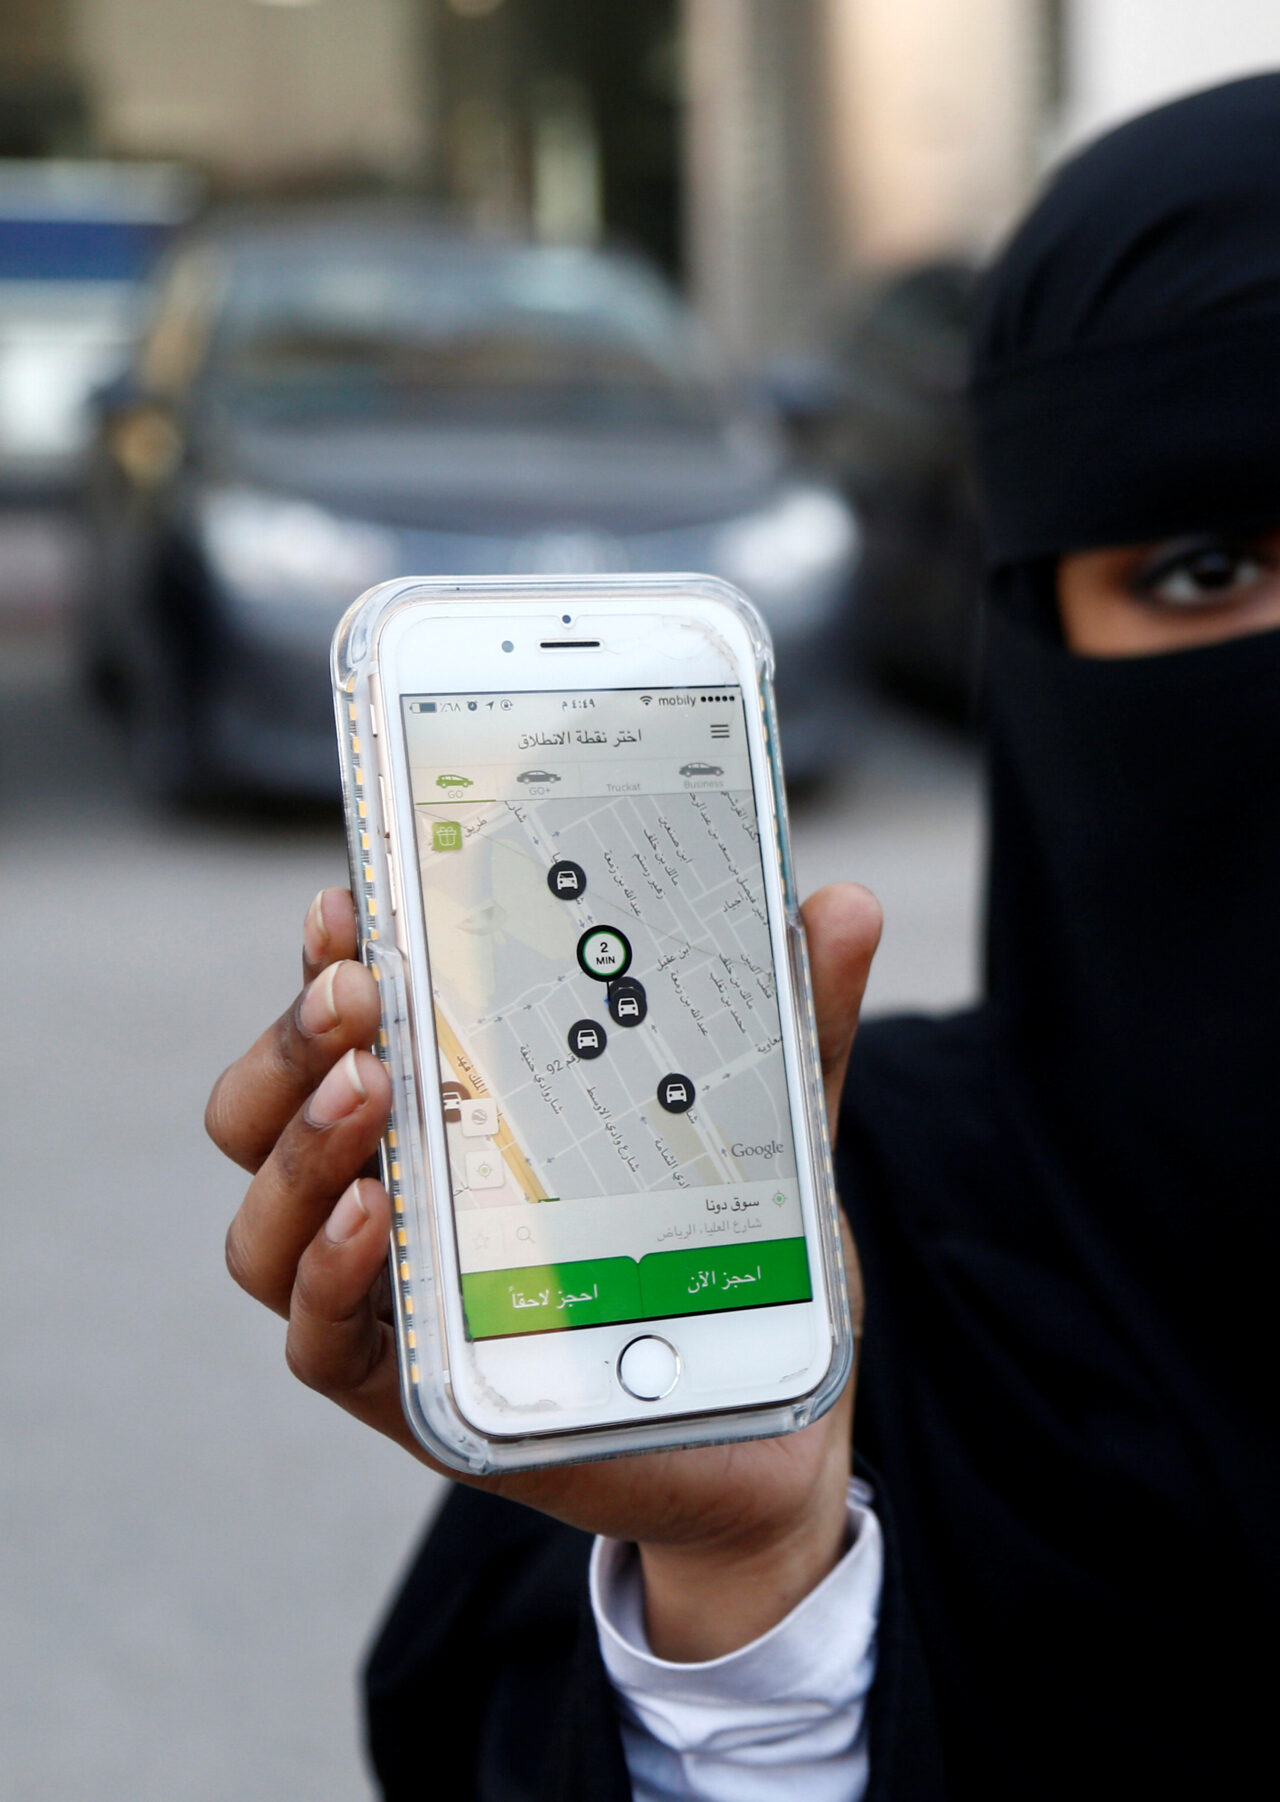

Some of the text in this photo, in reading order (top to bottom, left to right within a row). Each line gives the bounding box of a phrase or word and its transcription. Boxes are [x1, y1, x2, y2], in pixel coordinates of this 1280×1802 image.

[658, 695, 697, 707] mobily
[518, 729, 642, 750] اختر نقطة الانطلاق
[528, 786, 551, 795] GO+
[683, 779, 724, 790] Business
[447, 790, 464, 799] GO
[600, 941, 609, 953] 2
[596, 955, 615, 965] MIN
[546, 1059, 564, 1075] 92
[731, 1140, 784, 1160] Google
[705, 1197, 760, 1214] سوق دونا
[657, 1223, 696, 1242] الرياض
[733, 1218, 762, 1235] شارع
[687, 1270, 716, 1294] الآن
